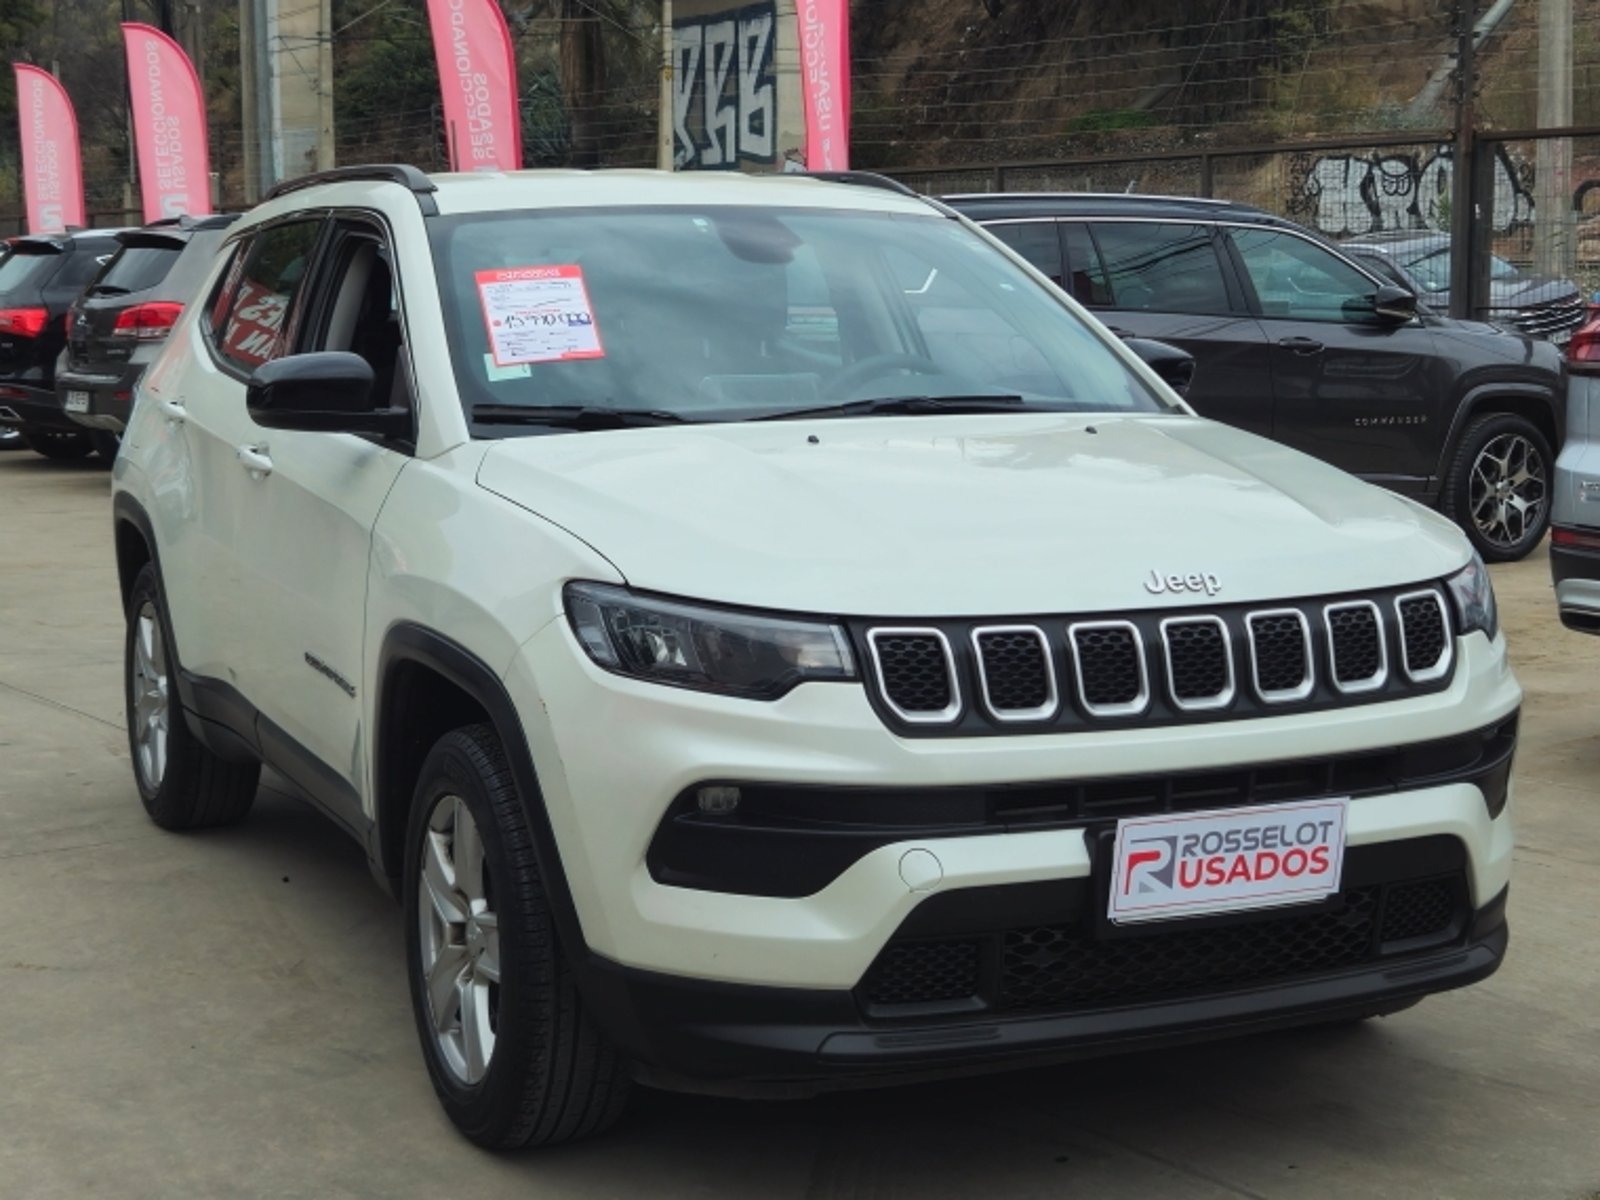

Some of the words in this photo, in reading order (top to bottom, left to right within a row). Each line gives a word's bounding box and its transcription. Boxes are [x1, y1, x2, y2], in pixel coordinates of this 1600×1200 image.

[1143, 569, 1222, 596] Jeep
[1182, 821, 1334, 857] ROSSELOT
[1178, 846, 1329, 889] USADOS
